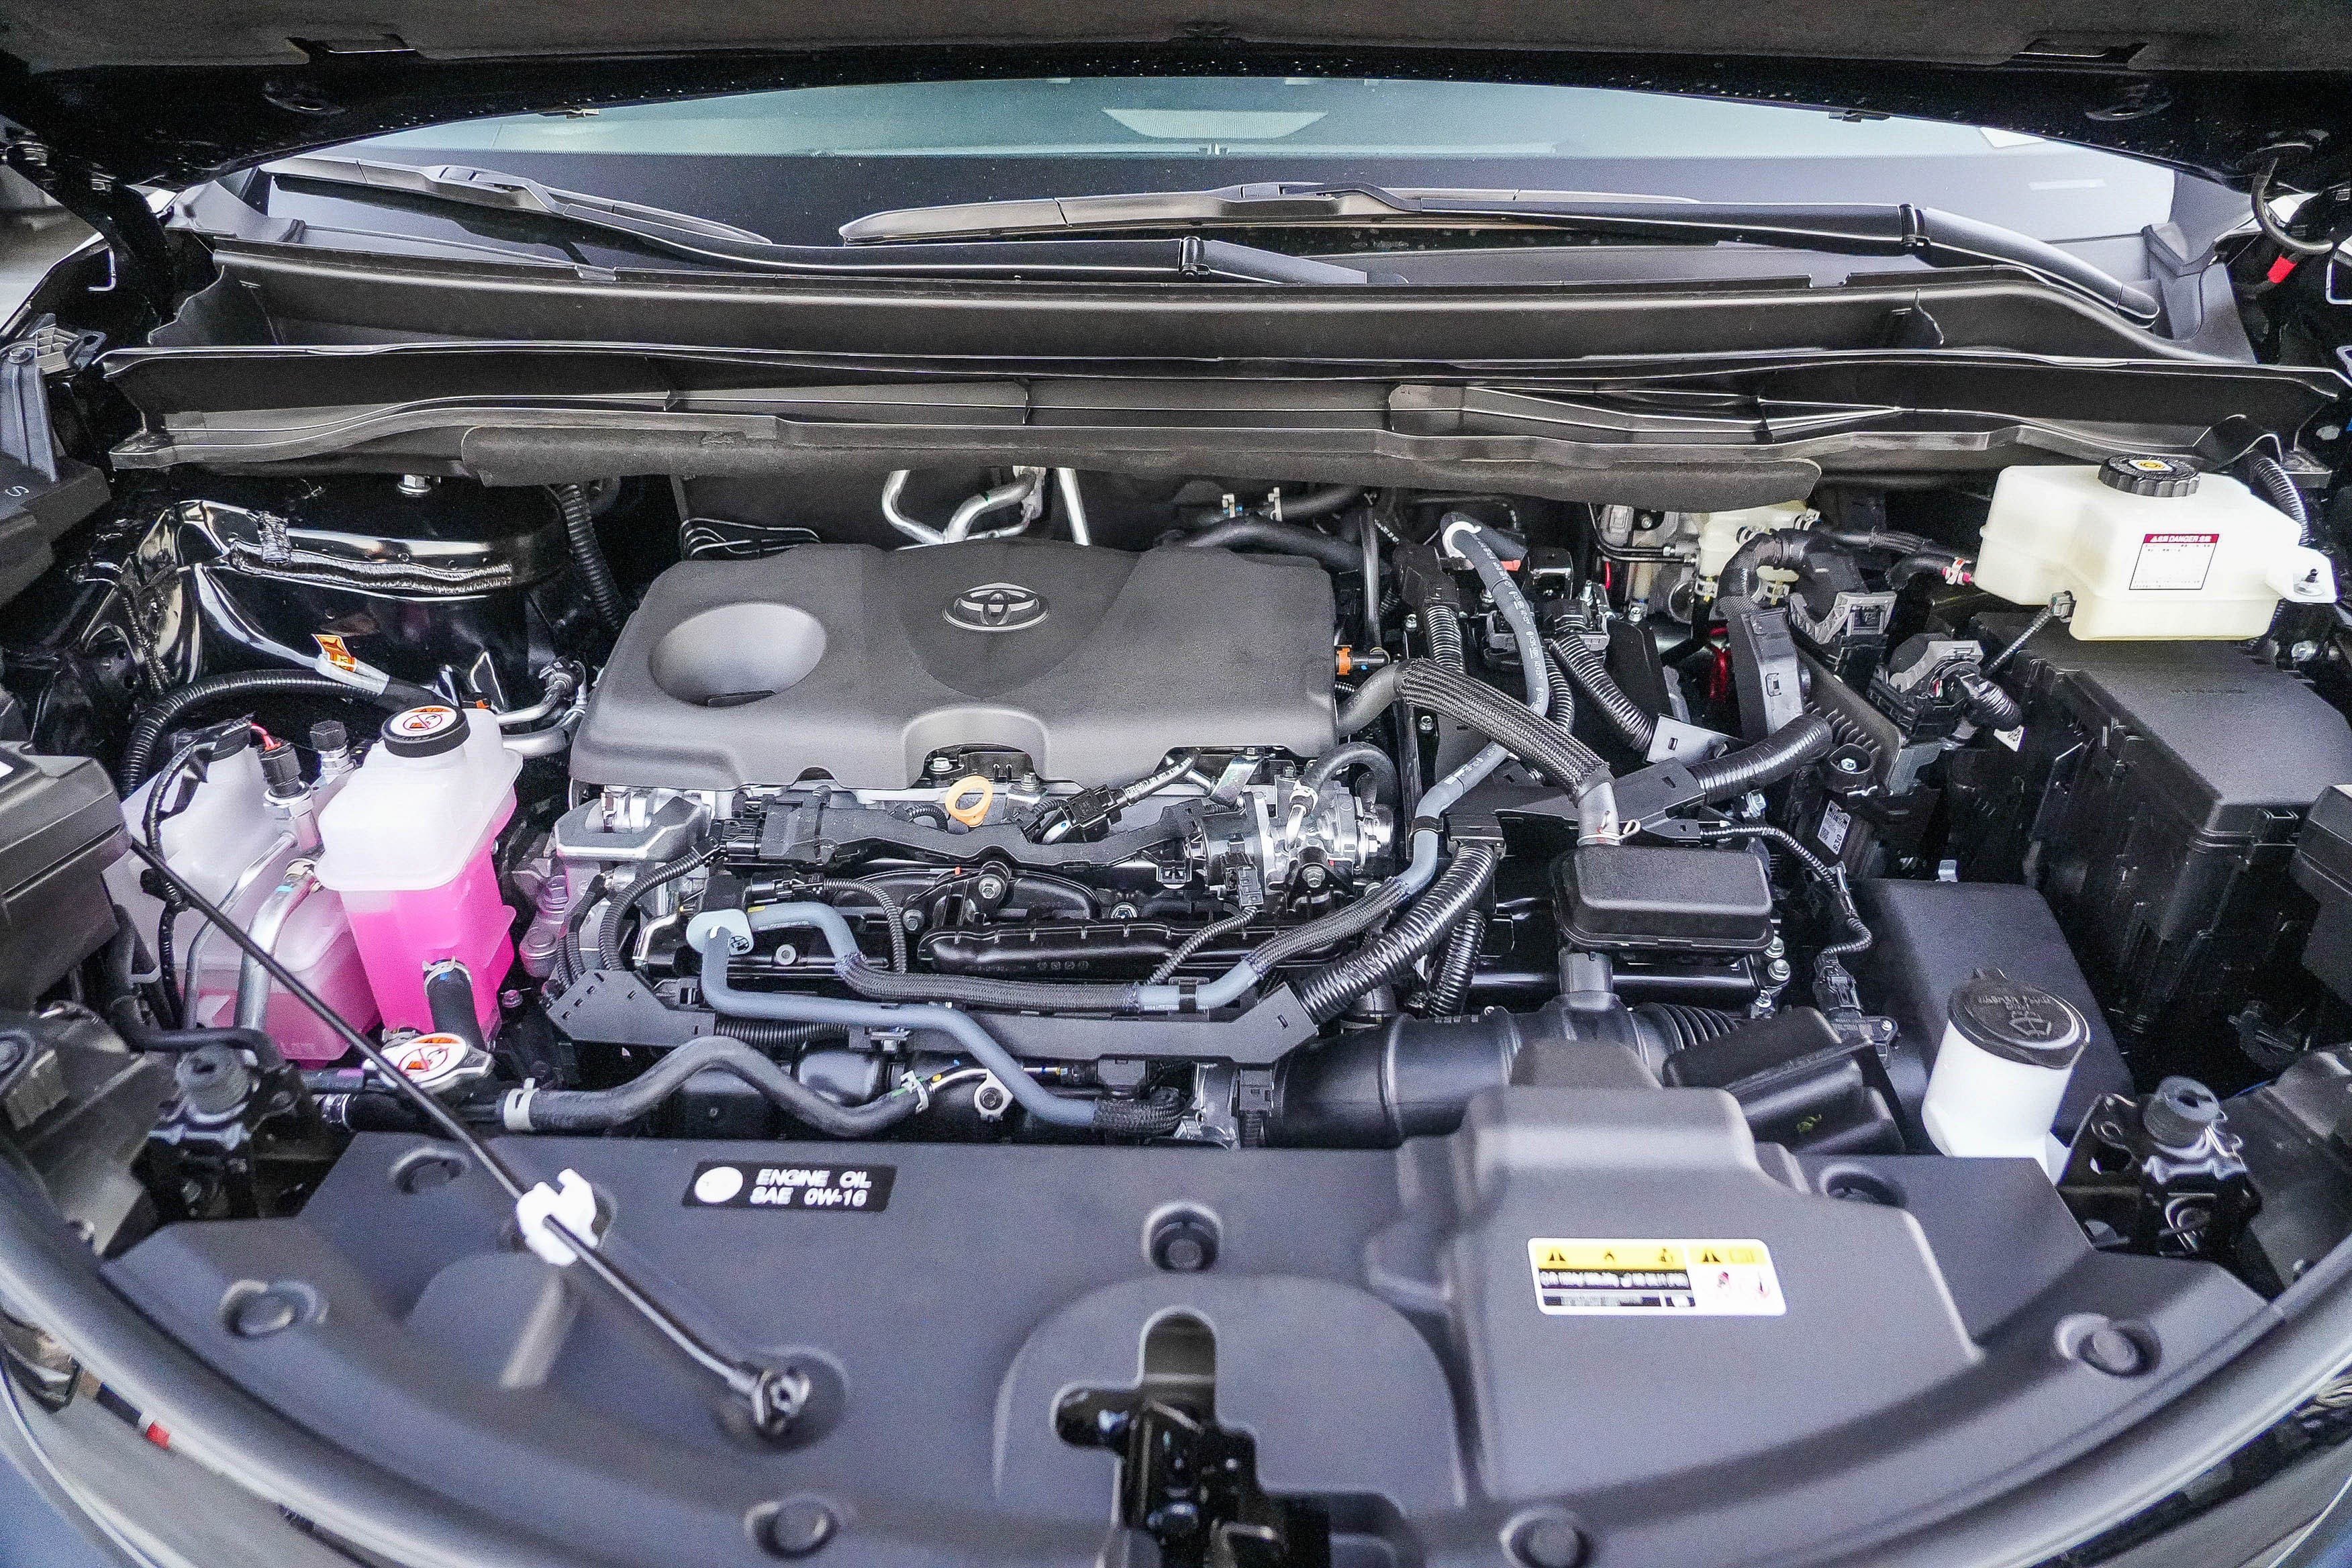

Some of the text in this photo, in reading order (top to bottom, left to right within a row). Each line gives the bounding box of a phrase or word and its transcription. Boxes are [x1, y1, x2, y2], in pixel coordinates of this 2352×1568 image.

[755, 1168, 872, 1189] ENGINE OIL
[749, 1186, 868, 1207] SAE 0W-16
